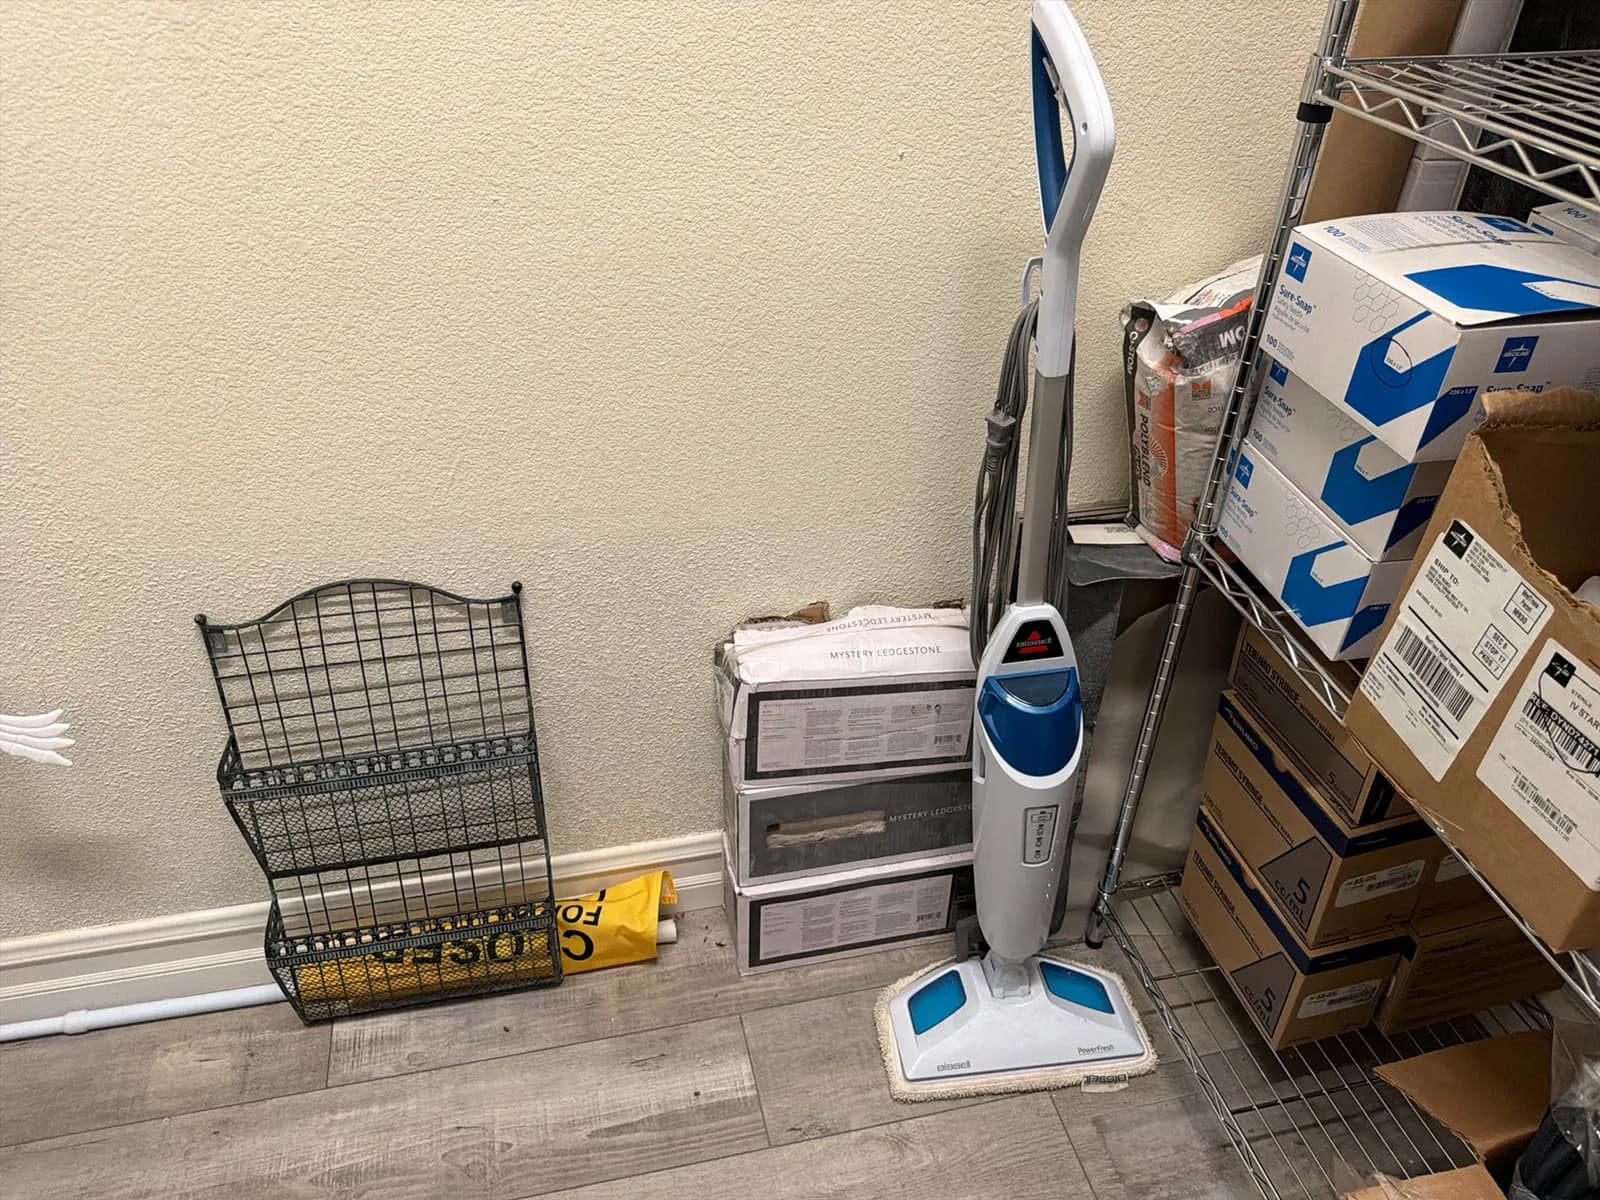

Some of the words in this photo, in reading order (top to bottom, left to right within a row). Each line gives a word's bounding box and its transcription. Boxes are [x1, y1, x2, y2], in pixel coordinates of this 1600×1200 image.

[1324, 224, 1347, 238] 100
[1126, 331, 1139, 375] CSTOM
[1266, 333, 1279, 348] 100
[1253, 428, 1264, 442] 100
[1139, 413, 1152, 487] POLYBLEND
[1434, 558, 1450, 574] SHIP
[1449, 573, 1460, 587] TO:
[891, 612, 933, 624] MYSTERY
[830, 649, 875, 660] MYSTERY
[877, 645, 943, 657] LEDGESTONE
[1484, 640, 1499, 656] STOP
[1492, 632, 1504, 646] SEC
[1244, 641, 1271, 674] TERUMO
[1270, 670, 1300, 704] SYRINGE
[1570, 700, 1580, 711] IV
[1579, 708, 1600, 733] STAR
[1230, 716, 1260, 752] TERUMO
[1214, 740, 1240, 773] TERUMO
[1239, 771, 1264, 805] SYRINGE
[889, 810, 928, 821] MYSTERY
[1192, 849, 1214, 882] TERUMO
[1213, 879, 1237, 914] SYRINGE
[1293, 876, 1311, 906] 5
[556, 904, 602, 926] FO
[1273, 879, 1305, 925] cc/mL
[1243, 984, 1272, 1031] cc/mL
[1261, 986, 1277, 1013] 5
[1077, 1043, 1115, 1056] PowerFresh
